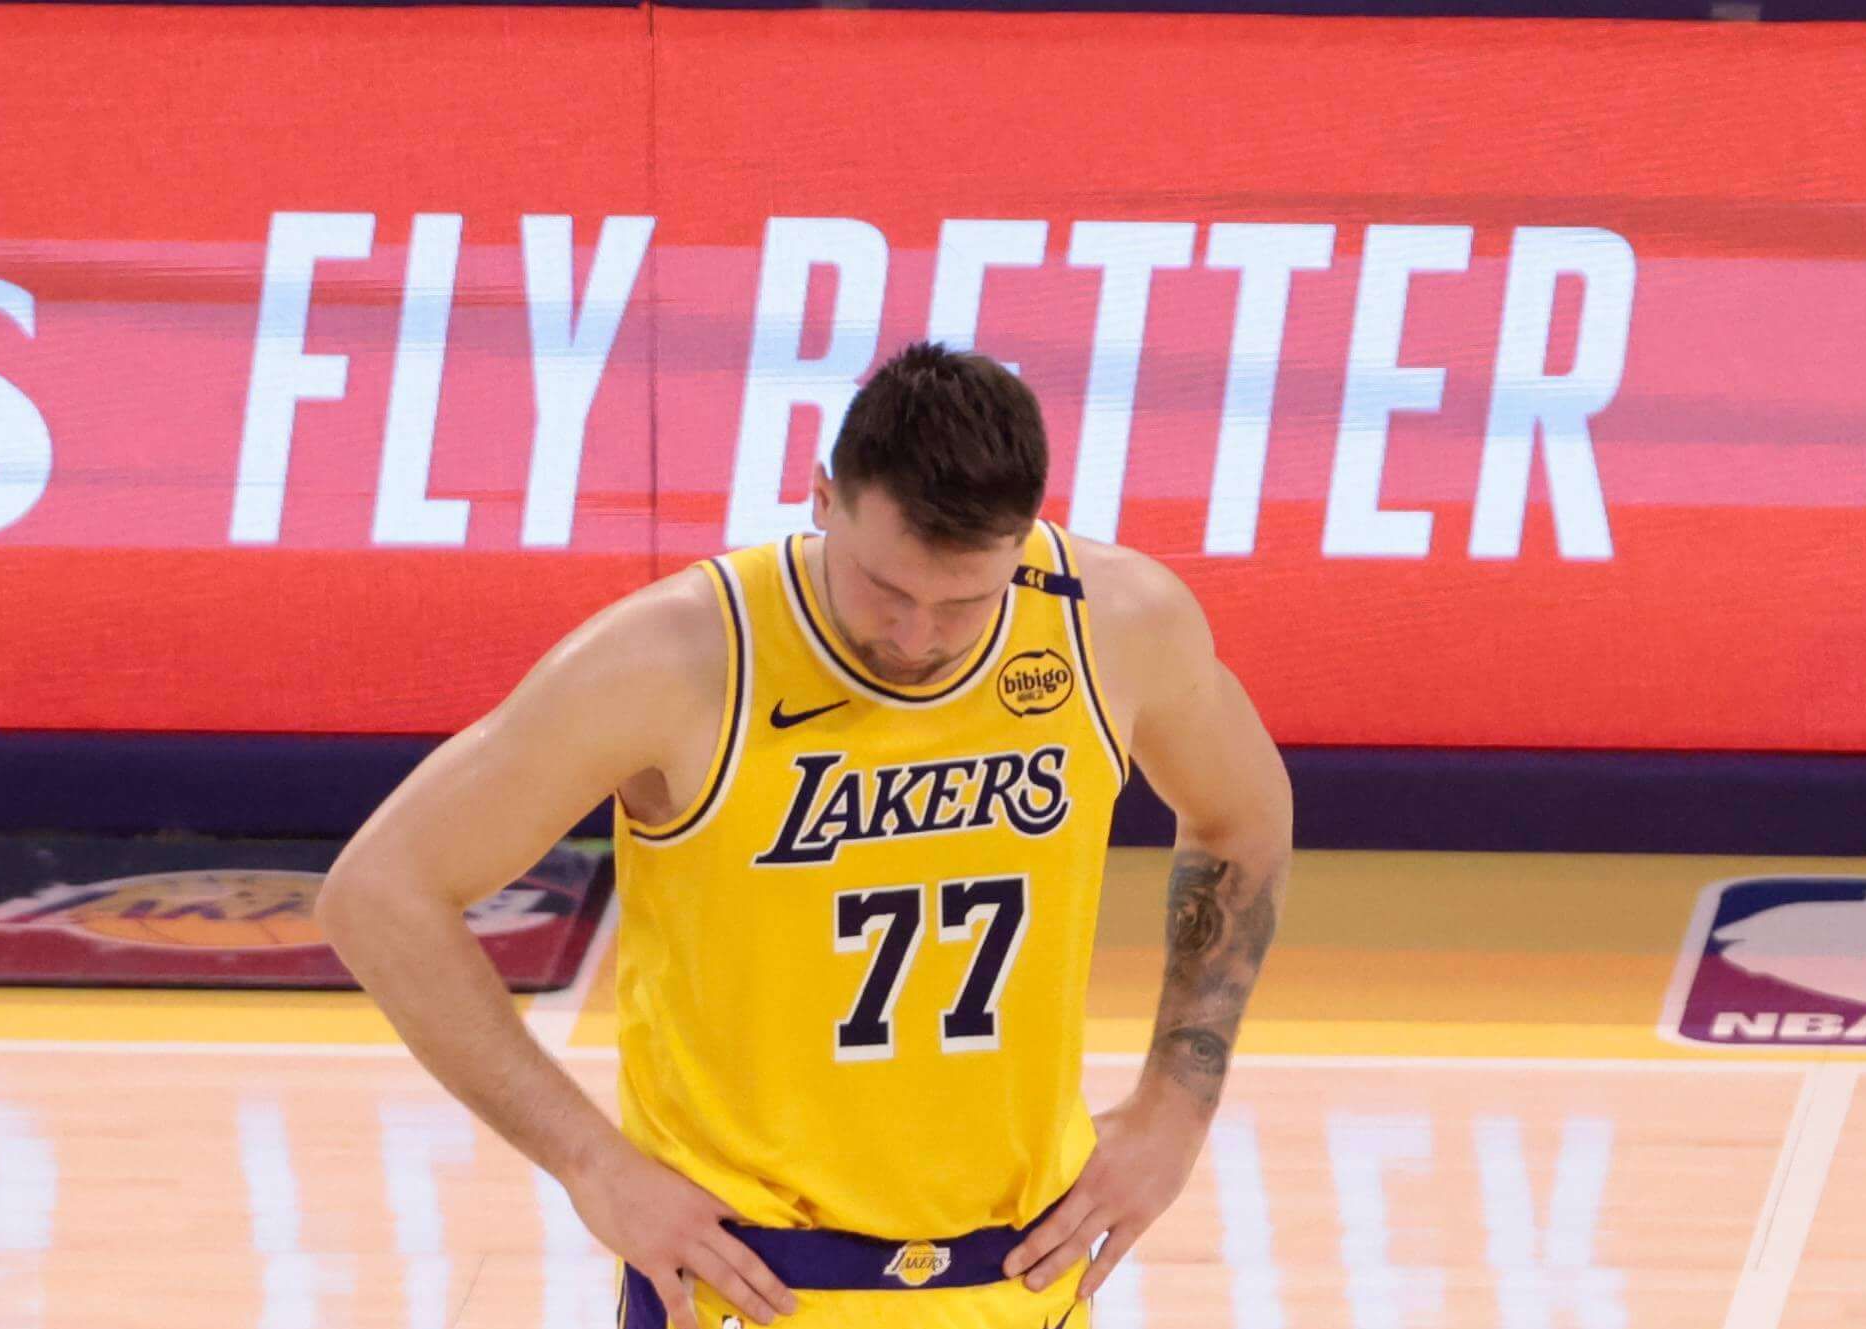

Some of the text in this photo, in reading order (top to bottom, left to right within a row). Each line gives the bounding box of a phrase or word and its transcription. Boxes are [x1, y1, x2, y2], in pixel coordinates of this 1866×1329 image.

[226, 210, 657, 550] FLY
[1004, 667, 1069, 694] bibigo
[751, 744, 1072, 868] LAKERS
[835, 873, 1030, 1062] 77
